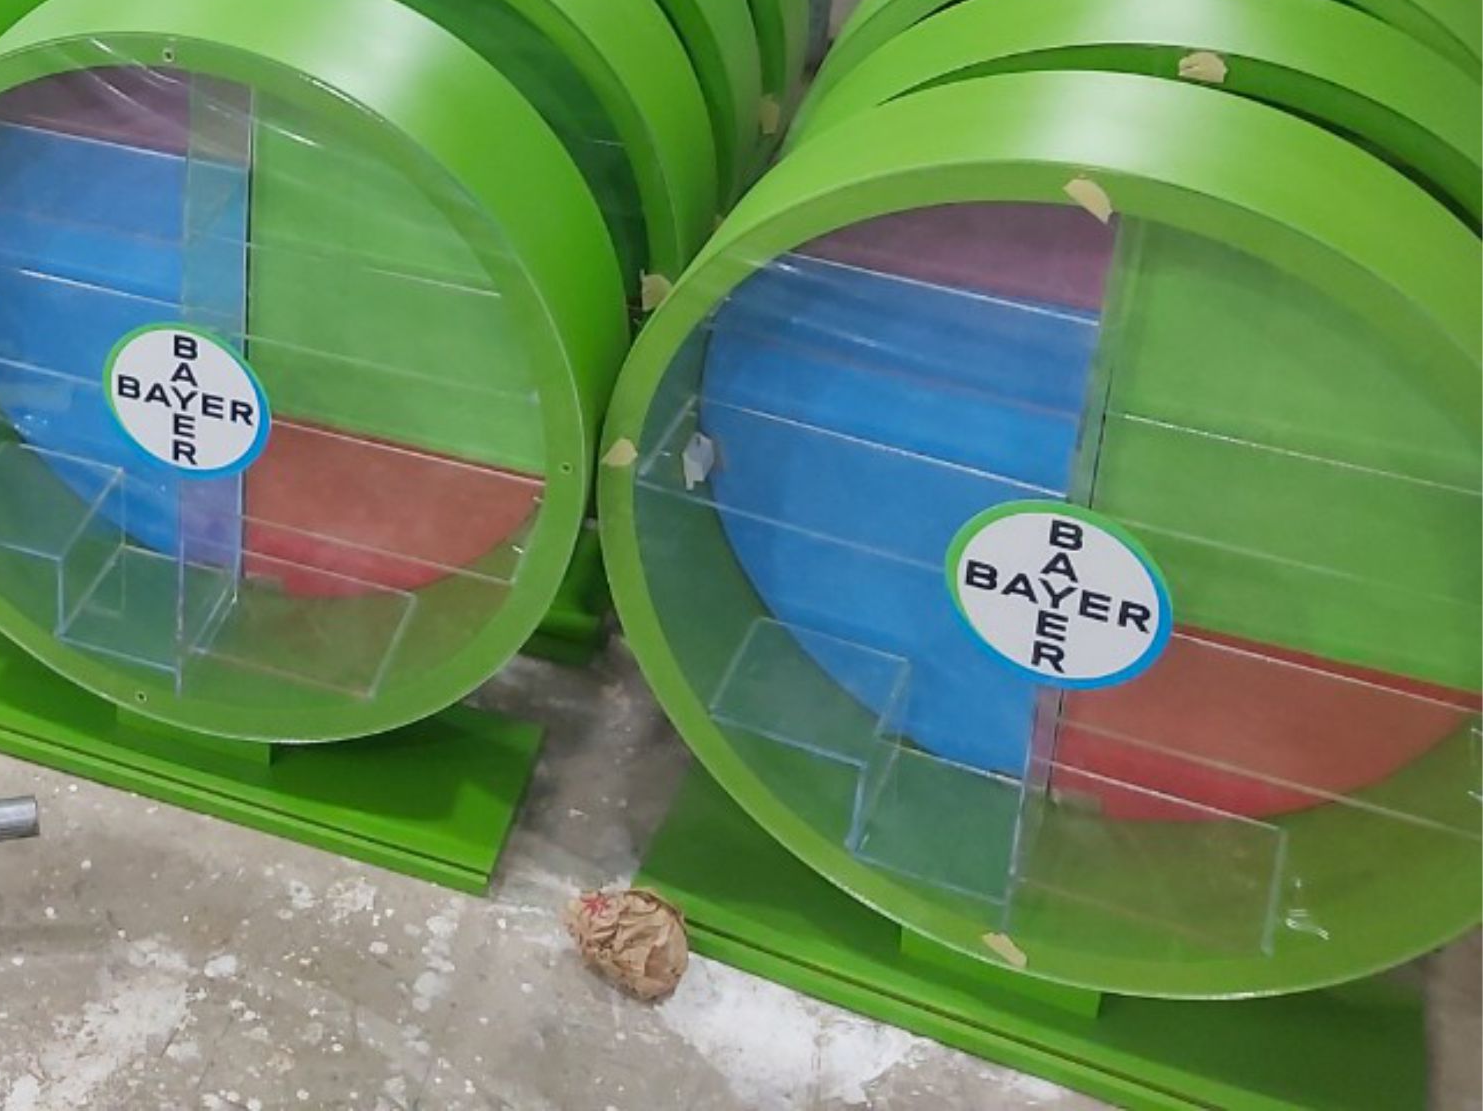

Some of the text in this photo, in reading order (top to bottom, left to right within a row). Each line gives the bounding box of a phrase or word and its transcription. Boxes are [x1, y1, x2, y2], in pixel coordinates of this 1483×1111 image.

[117, 374, 254, 426] BAYER
[170, 335, 198, 465] BAYER
[965, 560, 1151, 634] BAYER
[1031, 519, 1084, 674] BAYER
